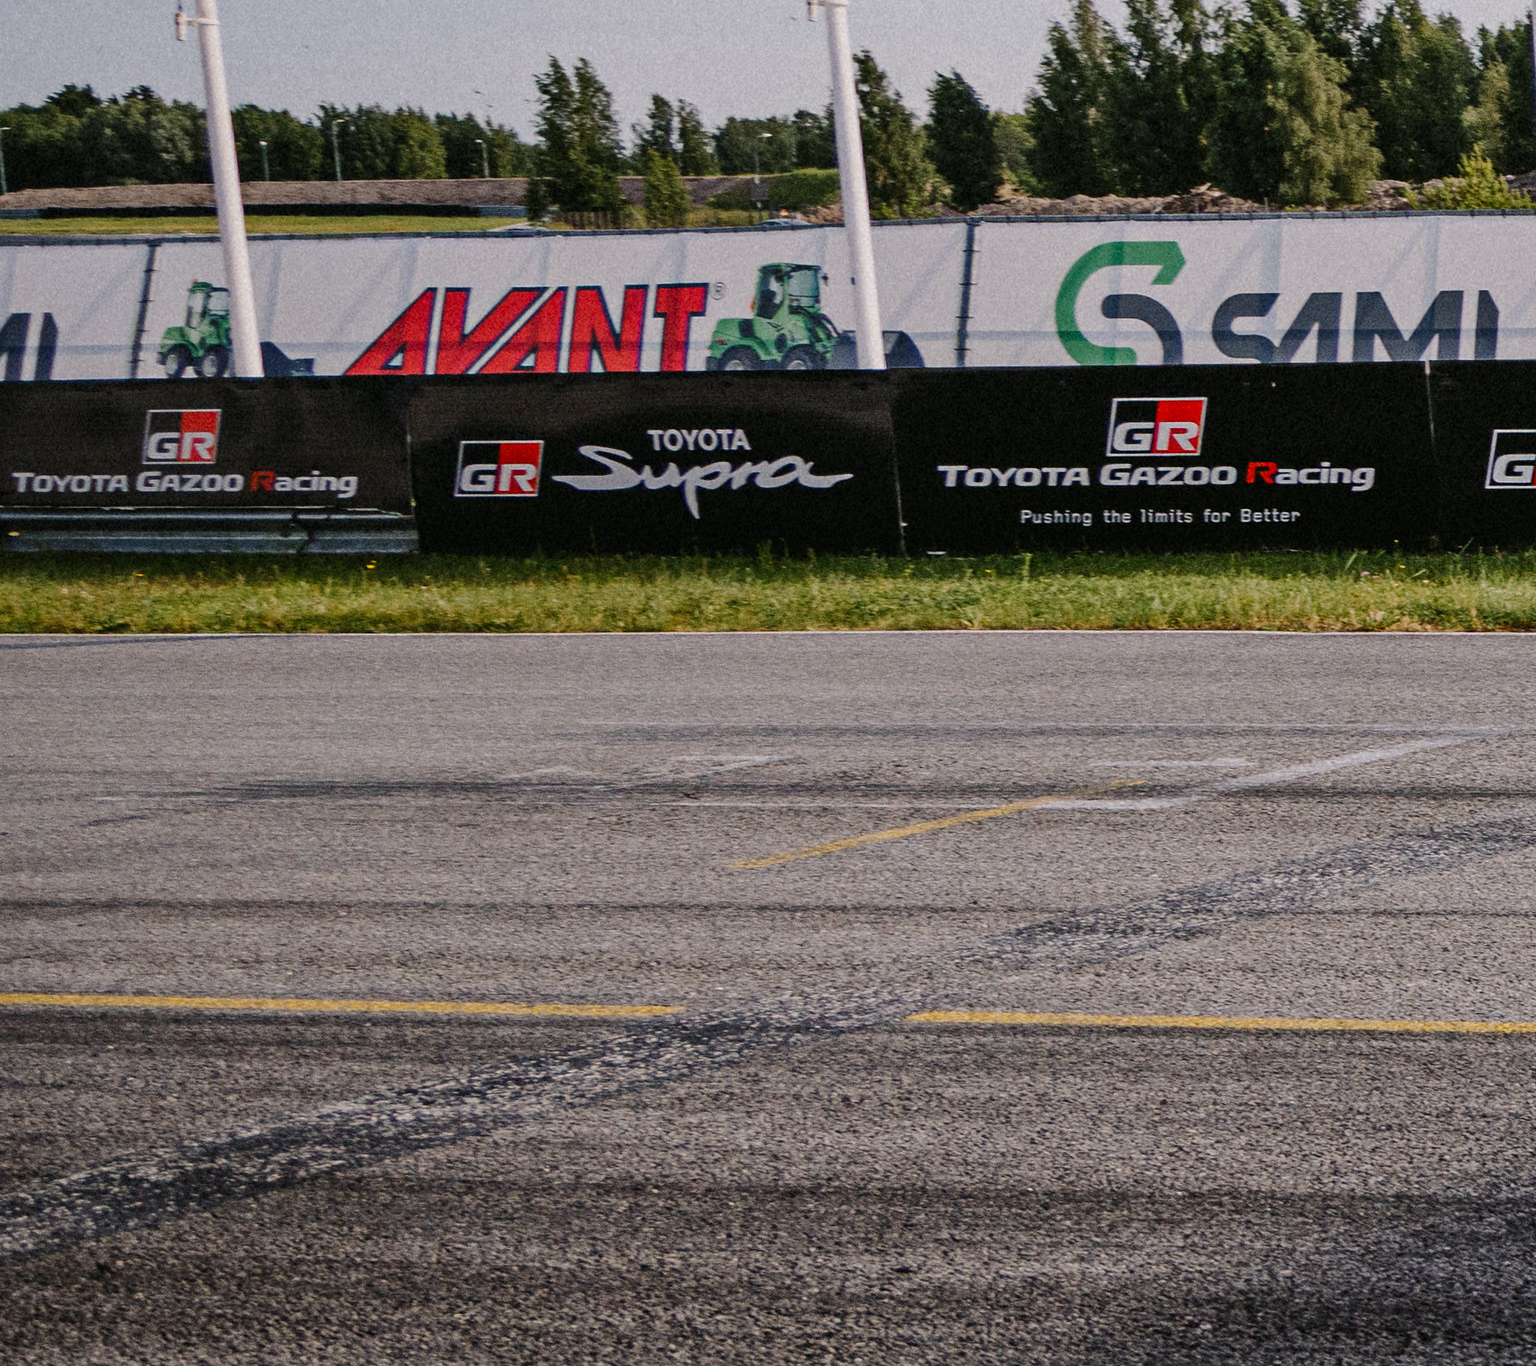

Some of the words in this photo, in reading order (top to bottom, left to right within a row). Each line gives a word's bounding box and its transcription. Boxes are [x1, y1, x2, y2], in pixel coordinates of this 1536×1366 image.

[1211, 290, 1500, 364] SAMI
[147, 430, 215, 461] GR
[647, 429, 751, 451] TOYOTA
[1111, 420, 1200, 452] GR
[12, 471, 128, 494] TOYOTA
[136, 470, 244, 493] GAZOO
[250, 470, 359, 499] Racing
[459, 463, 538, 493] GR
[552, 445, 854, 519] Supra
[938, 464, 1091, 488] TOYOTA
[1100, 463, 1237, 486] GAZOO
[1246, 461, 1376, 492] Racing
[1020, 509, 1093, 527] Pushing
[1103, 509, 1131, 524] the
[1140, 509, 1193, 524] limits
[1203, 508, 1232, 523] for
[1240, 508, 1300, 523] Better
